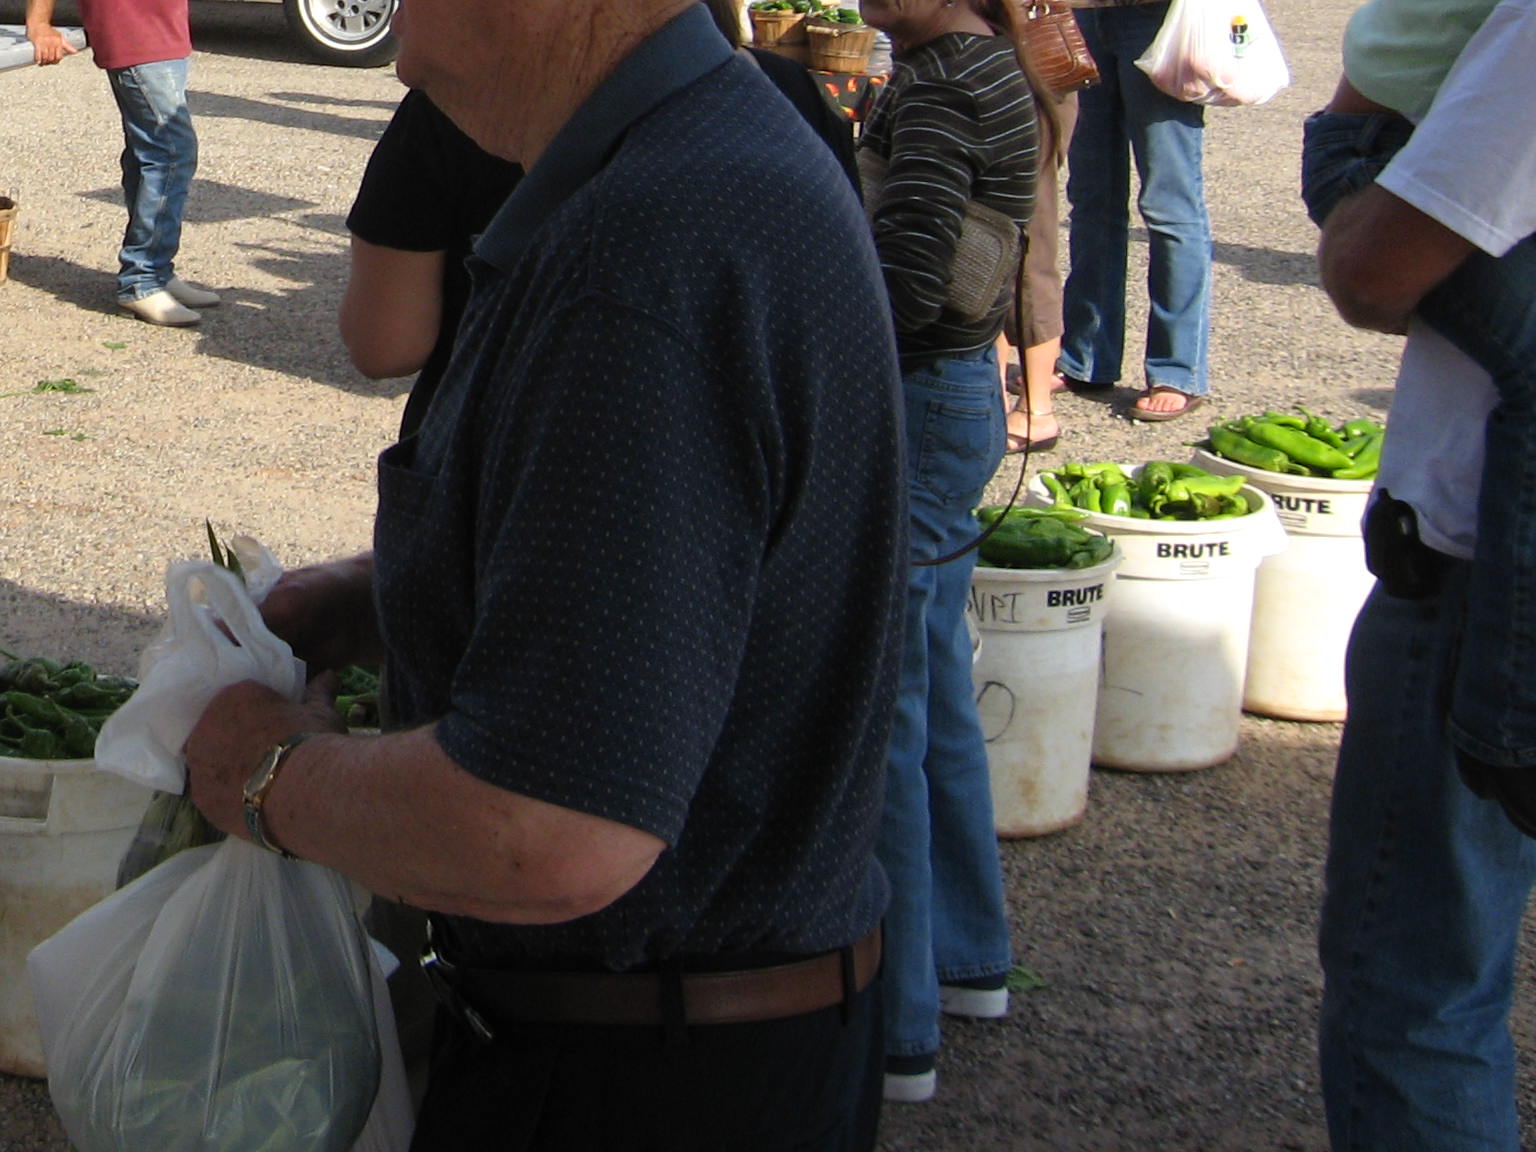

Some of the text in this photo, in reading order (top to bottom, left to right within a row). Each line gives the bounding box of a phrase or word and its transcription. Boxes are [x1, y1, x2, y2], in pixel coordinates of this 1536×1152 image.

[1271, 494, 1333, 514] RUTE
[1157, 541, 1231, 559] BRUTE
[1047, 584, 1104, 608] BRUTE
